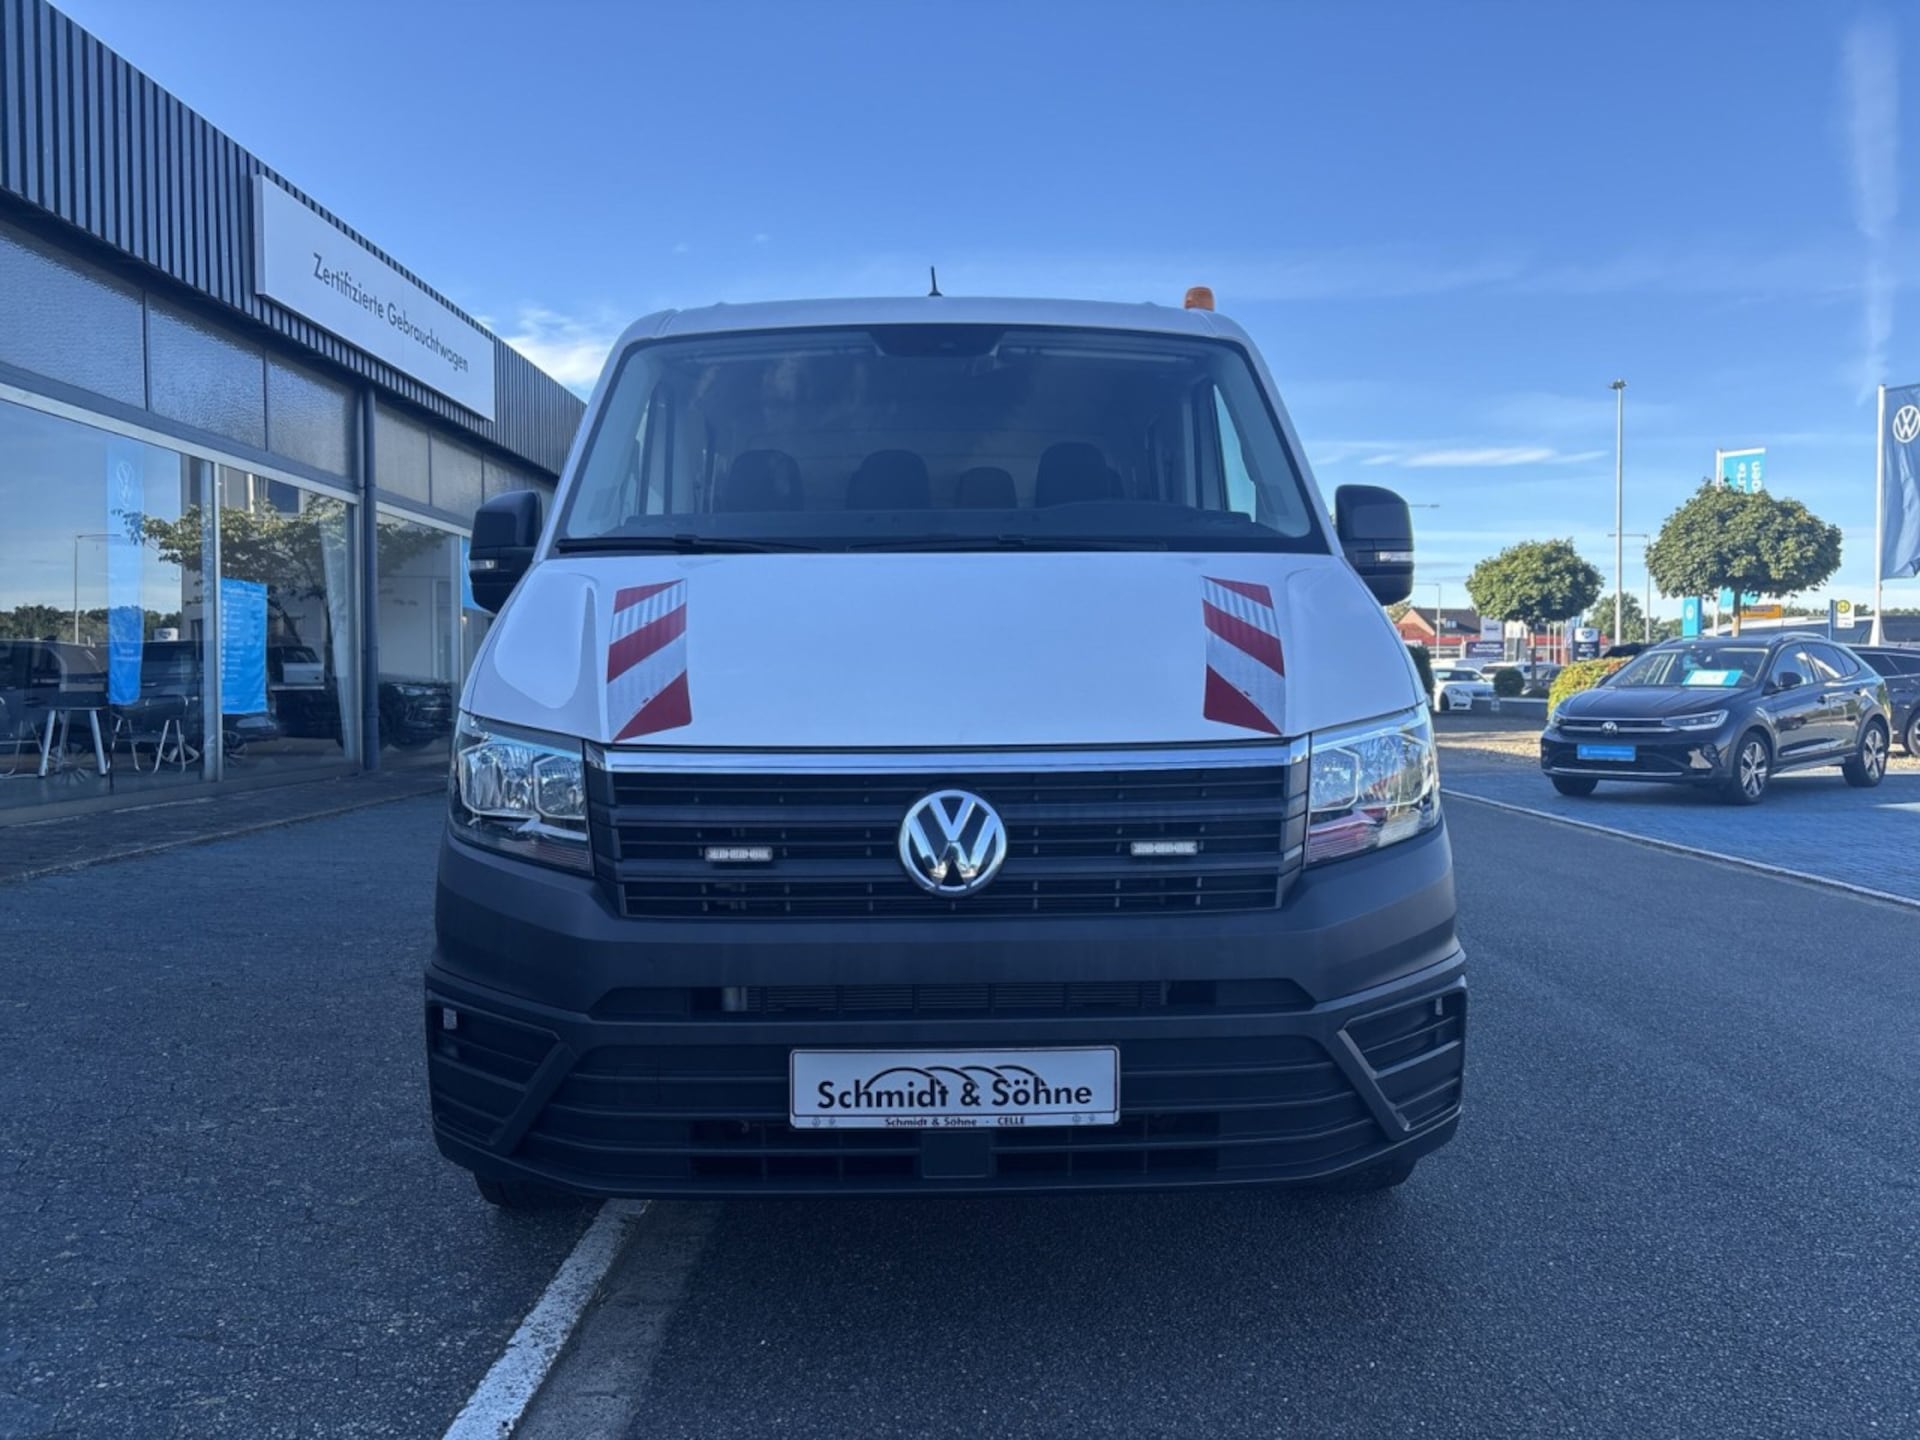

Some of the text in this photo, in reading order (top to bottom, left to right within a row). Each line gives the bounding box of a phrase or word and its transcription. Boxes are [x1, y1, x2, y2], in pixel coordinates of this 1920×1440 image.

[313, 252, 469, 374] Zertifizierte Gebrauchtwagen
[817, 1077, 1093, 1109] Schmidt & Söhne
[885, 1117, 927, 1126] Schmidt
[931, 1117, 940, 1126] &
[943, 1116, 977, 1126] Söhne
[997, 1116, 1025, 1125] CELLE
